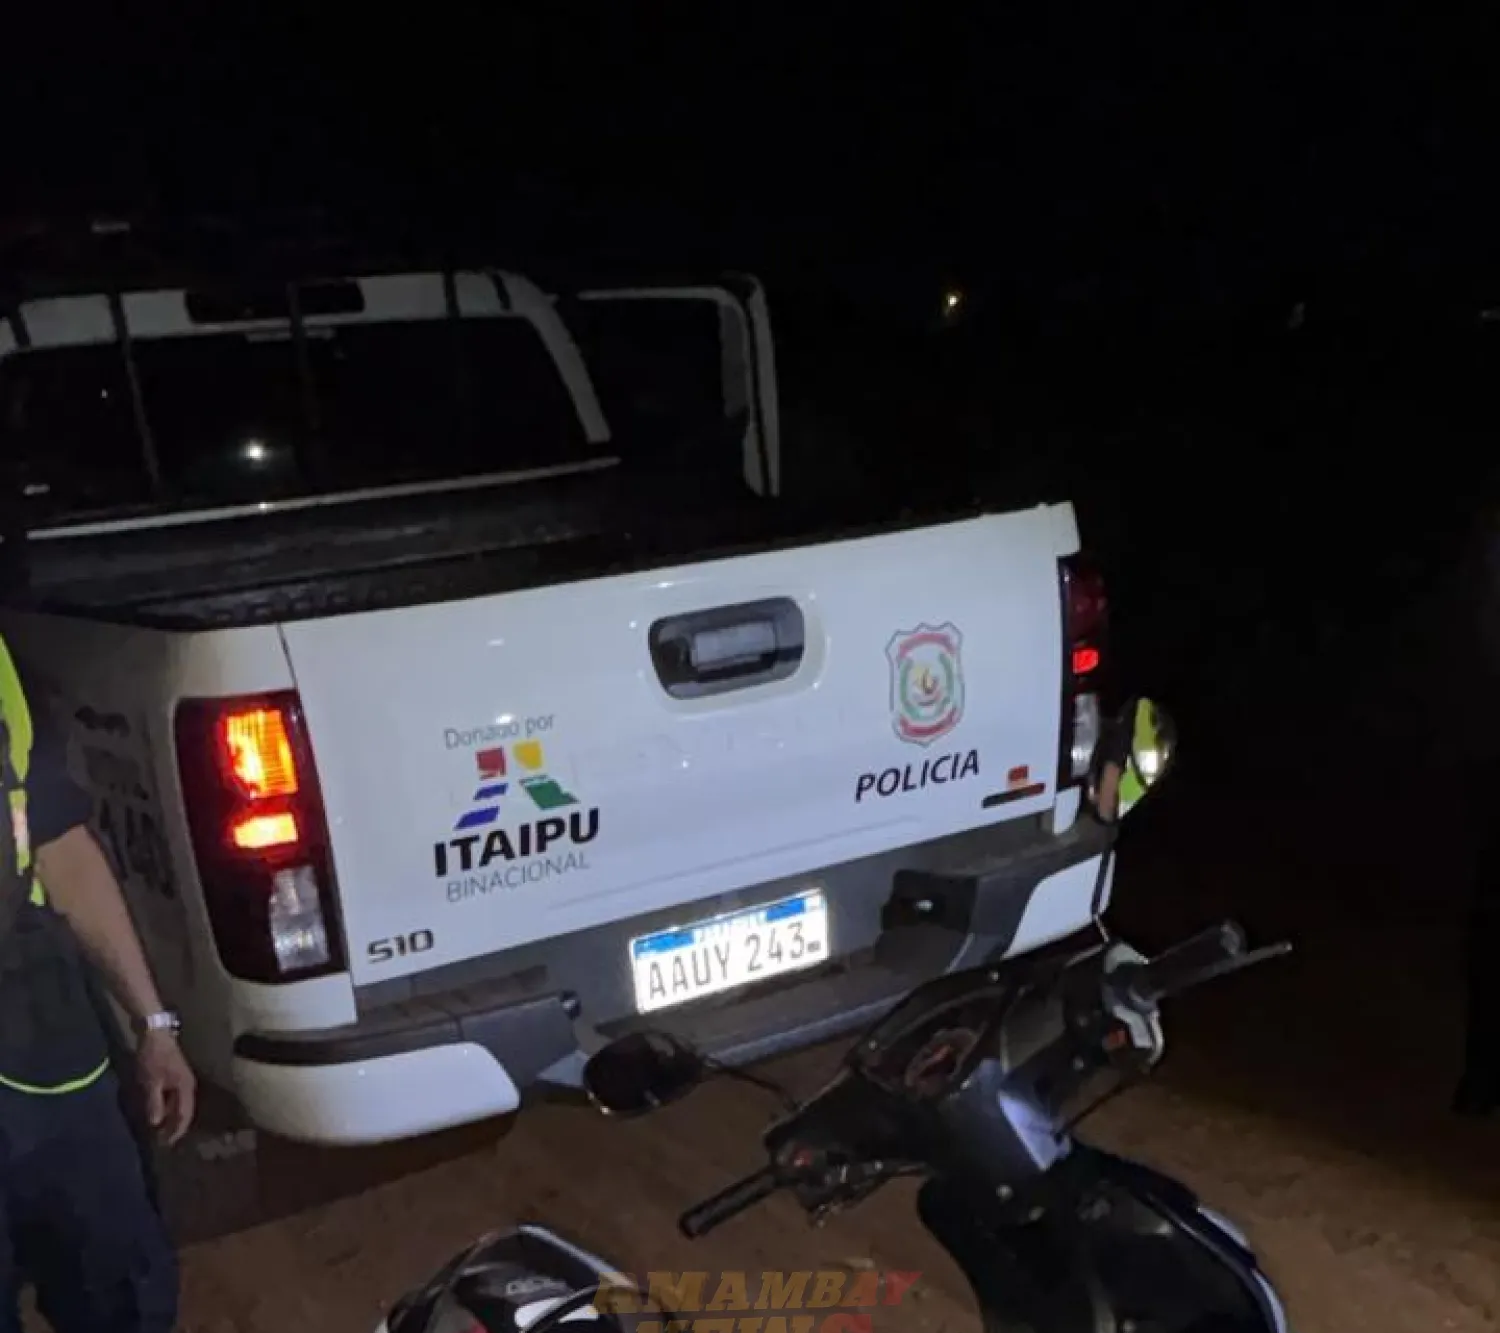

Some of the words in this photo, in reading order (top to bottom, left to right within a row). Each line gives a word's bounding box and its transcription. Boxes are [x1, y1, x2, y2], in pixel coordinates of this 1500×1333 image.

[444, 720, 519, 749] Donado
[525, 714, 554, 738] por
[855, 749, 979, 803] POLICIA
[434, 807, 599, 878] ITAIPU
[446, 851, 591, 902] BINACIONAL
[367, 928, 434, 964] S10
[649, 940, 730, 1000] AAUY
[746, 920, 804, 973] 243
